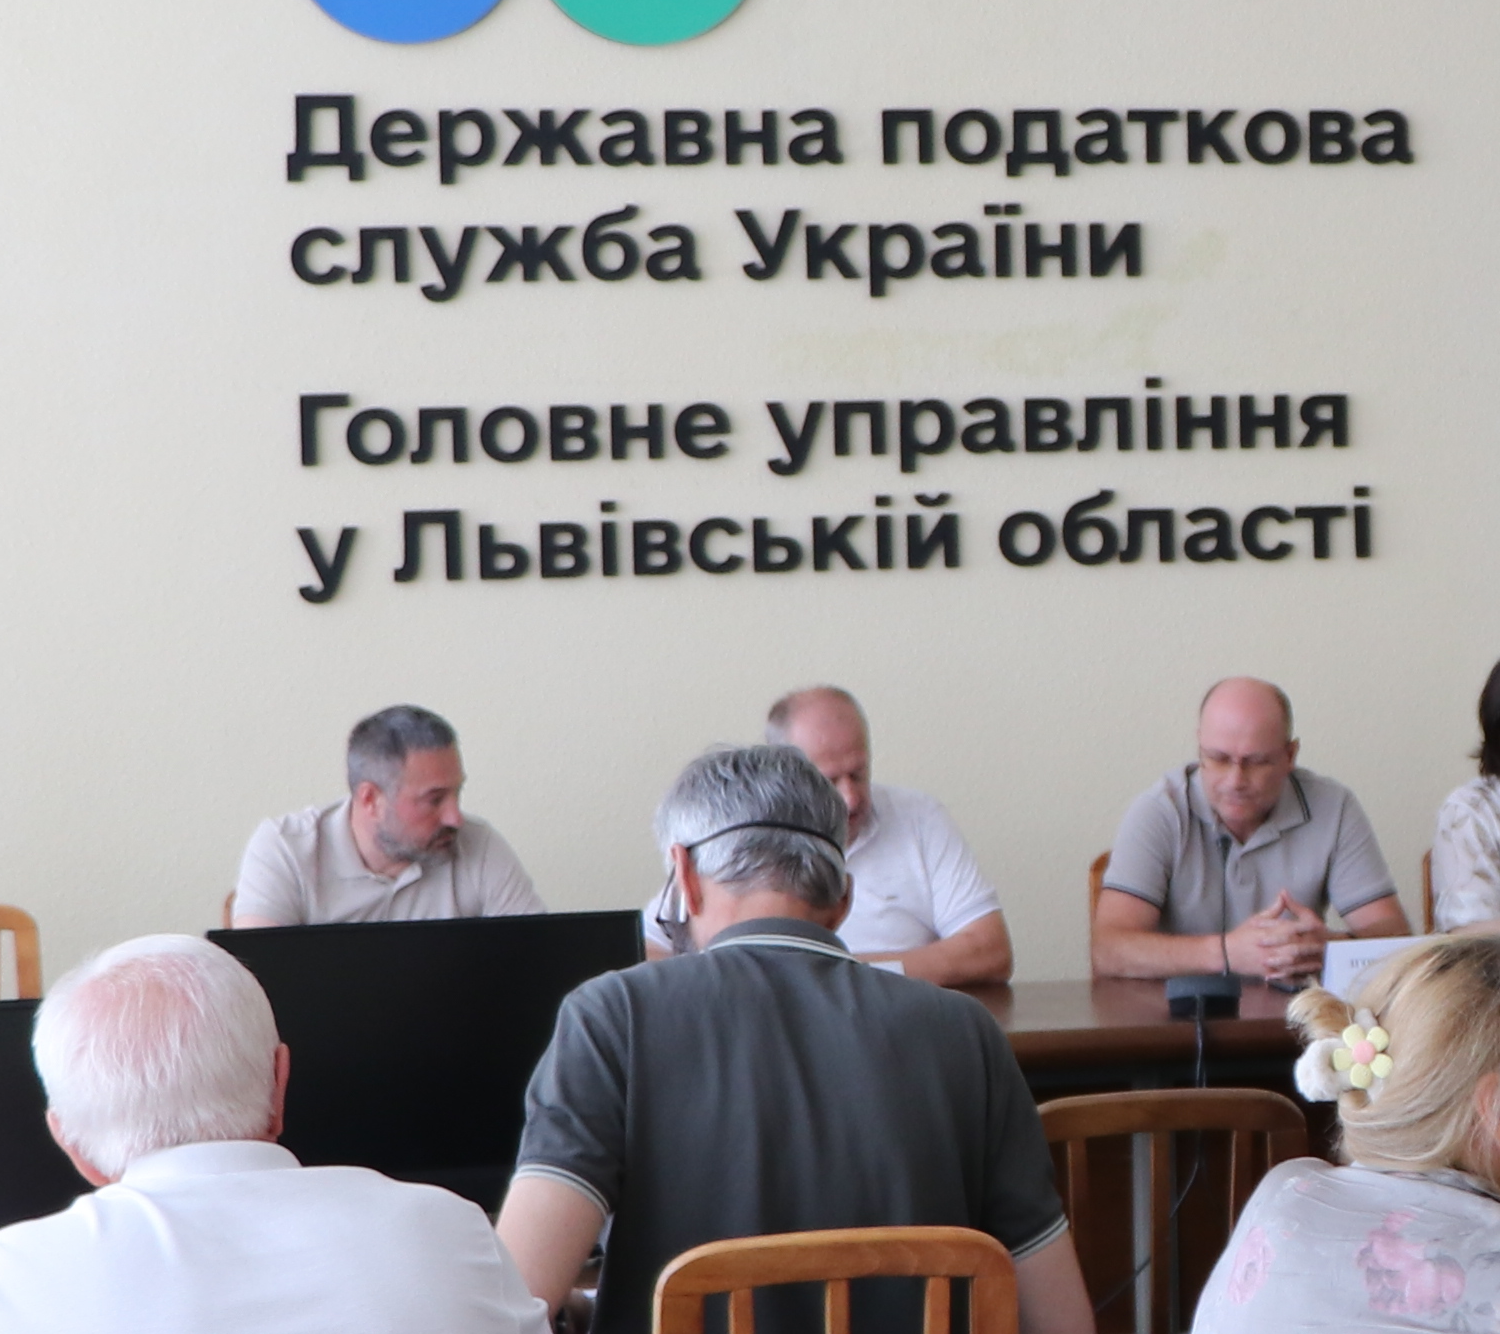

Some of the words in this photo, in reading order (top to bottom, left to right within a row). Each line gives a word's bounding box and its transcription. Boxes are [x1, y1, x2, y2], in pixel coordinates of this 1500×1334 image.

[285, 94, 845, 186] Державна
[880, 107, 1416, 179] податкова
[289, 203, 703, 303] служба
[735, 203, 1144, 298] України
[298, 392, 733, 468] Головне
[765, 377, 1351, 477] управління
[296, 525, 359, 605] у
[392, 492, 962, 584] Львівській
[997, 486, 1375, 568] області
